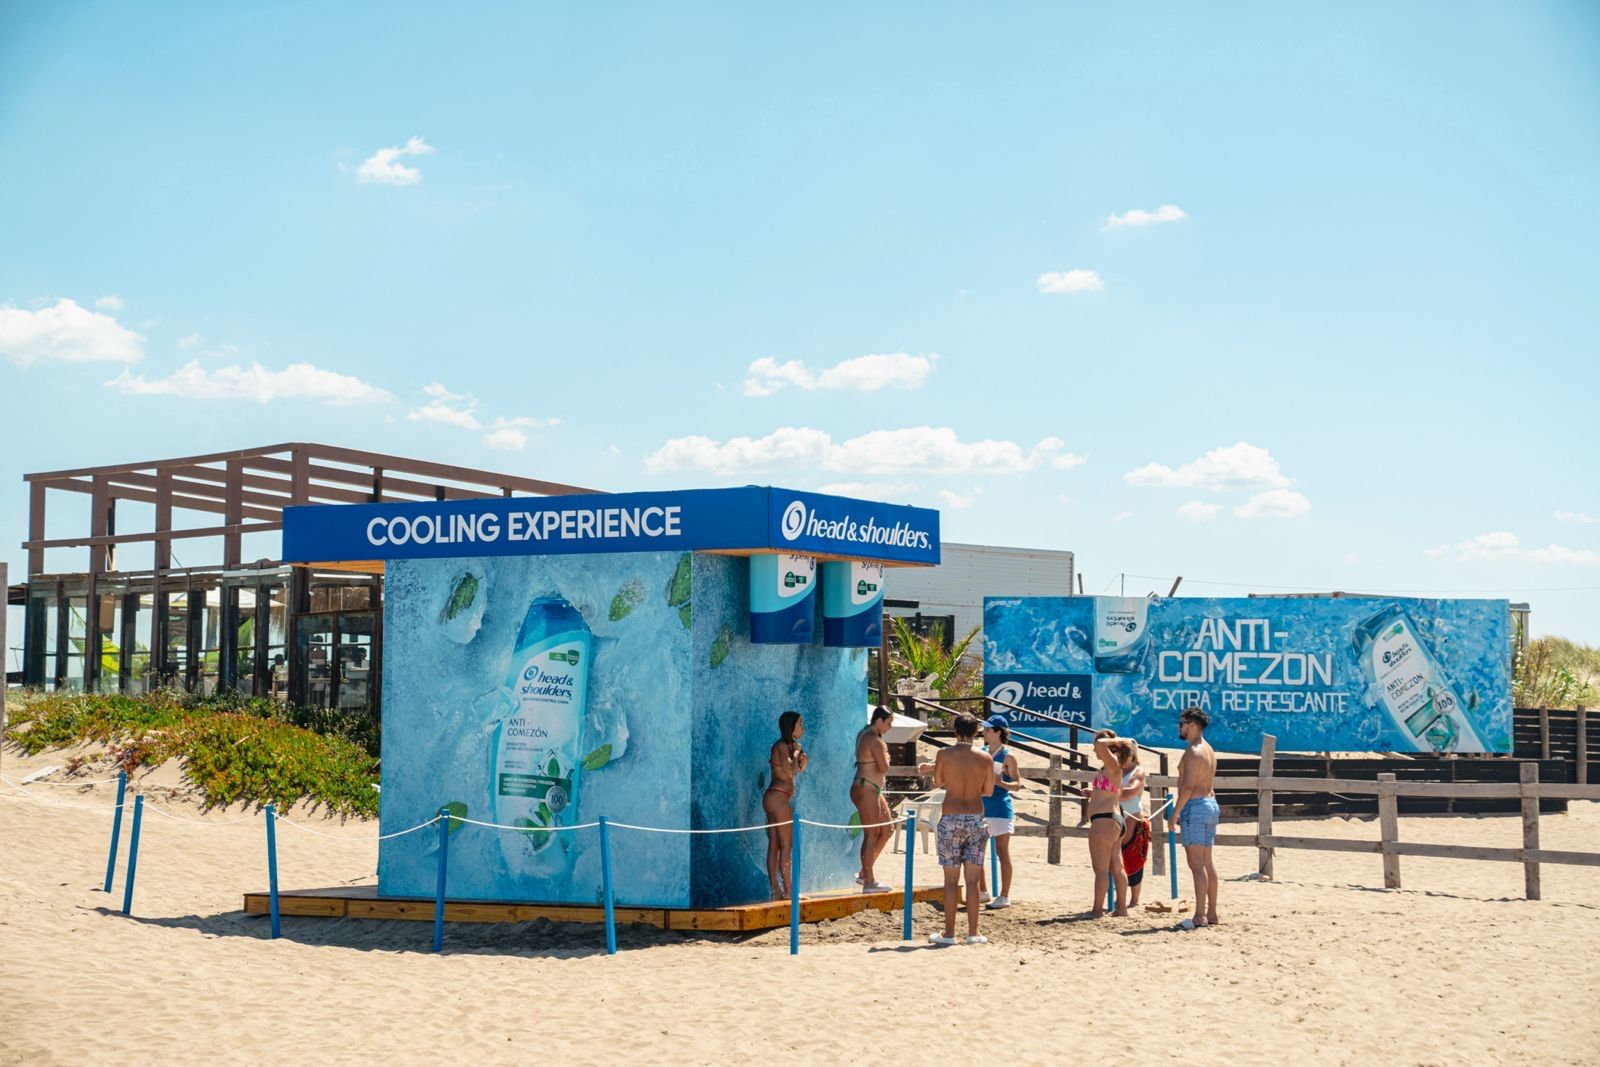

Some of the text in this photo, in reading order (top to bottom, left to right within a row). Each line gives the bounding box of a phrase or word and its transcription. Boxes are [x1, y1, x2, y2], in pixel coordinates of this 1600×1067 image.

[366, 506, 681, 546] COOLING EXPERIENCE
[1193, 618, 1289, 650] ANTI-
[1158, 650, 1332, 686] COMEZON
[1026, 681, 1070, 698] head
[1152, 688, 1351, 713] EXTRA REFRESCANTE
[1437, 697, 1453, 710] 100
[551, 793, 564, 803] 100
